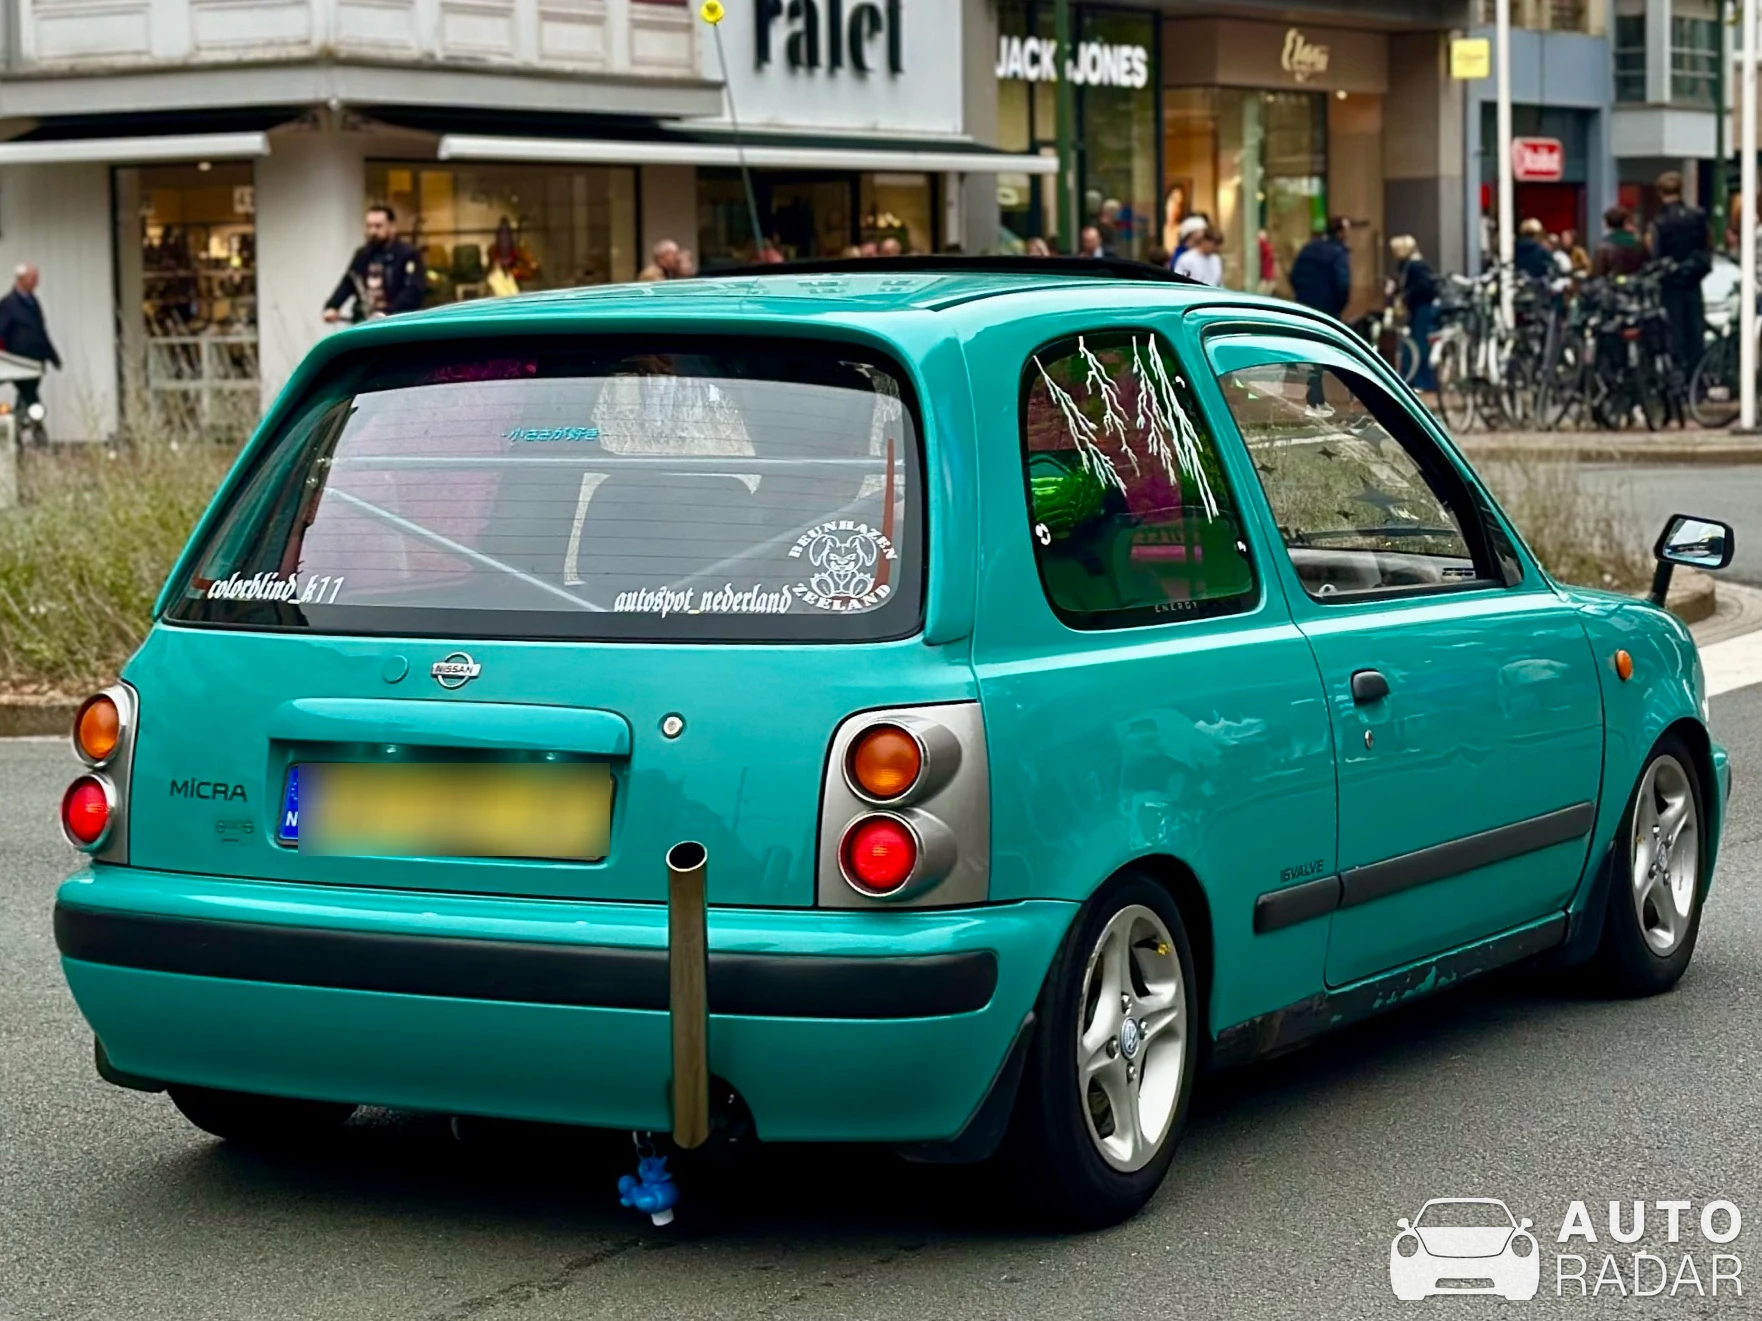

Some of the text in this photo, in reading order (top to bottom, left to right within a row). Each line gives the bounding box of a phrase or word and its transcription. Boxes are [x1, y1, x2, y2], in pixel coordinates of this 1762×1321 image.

[995, 36, 1058, 82] JACK
[1074, 42, 1148, 88] JONES
[788, 520, 898, 559] BEUNHAZEN
[613, 582, 792, 619] autospot_nederland
[791, 583, 891, 611] ZEELAND
[1154, 601, 1198, 613] ENERGY
[435, 664, 474, 675] NISSAN
